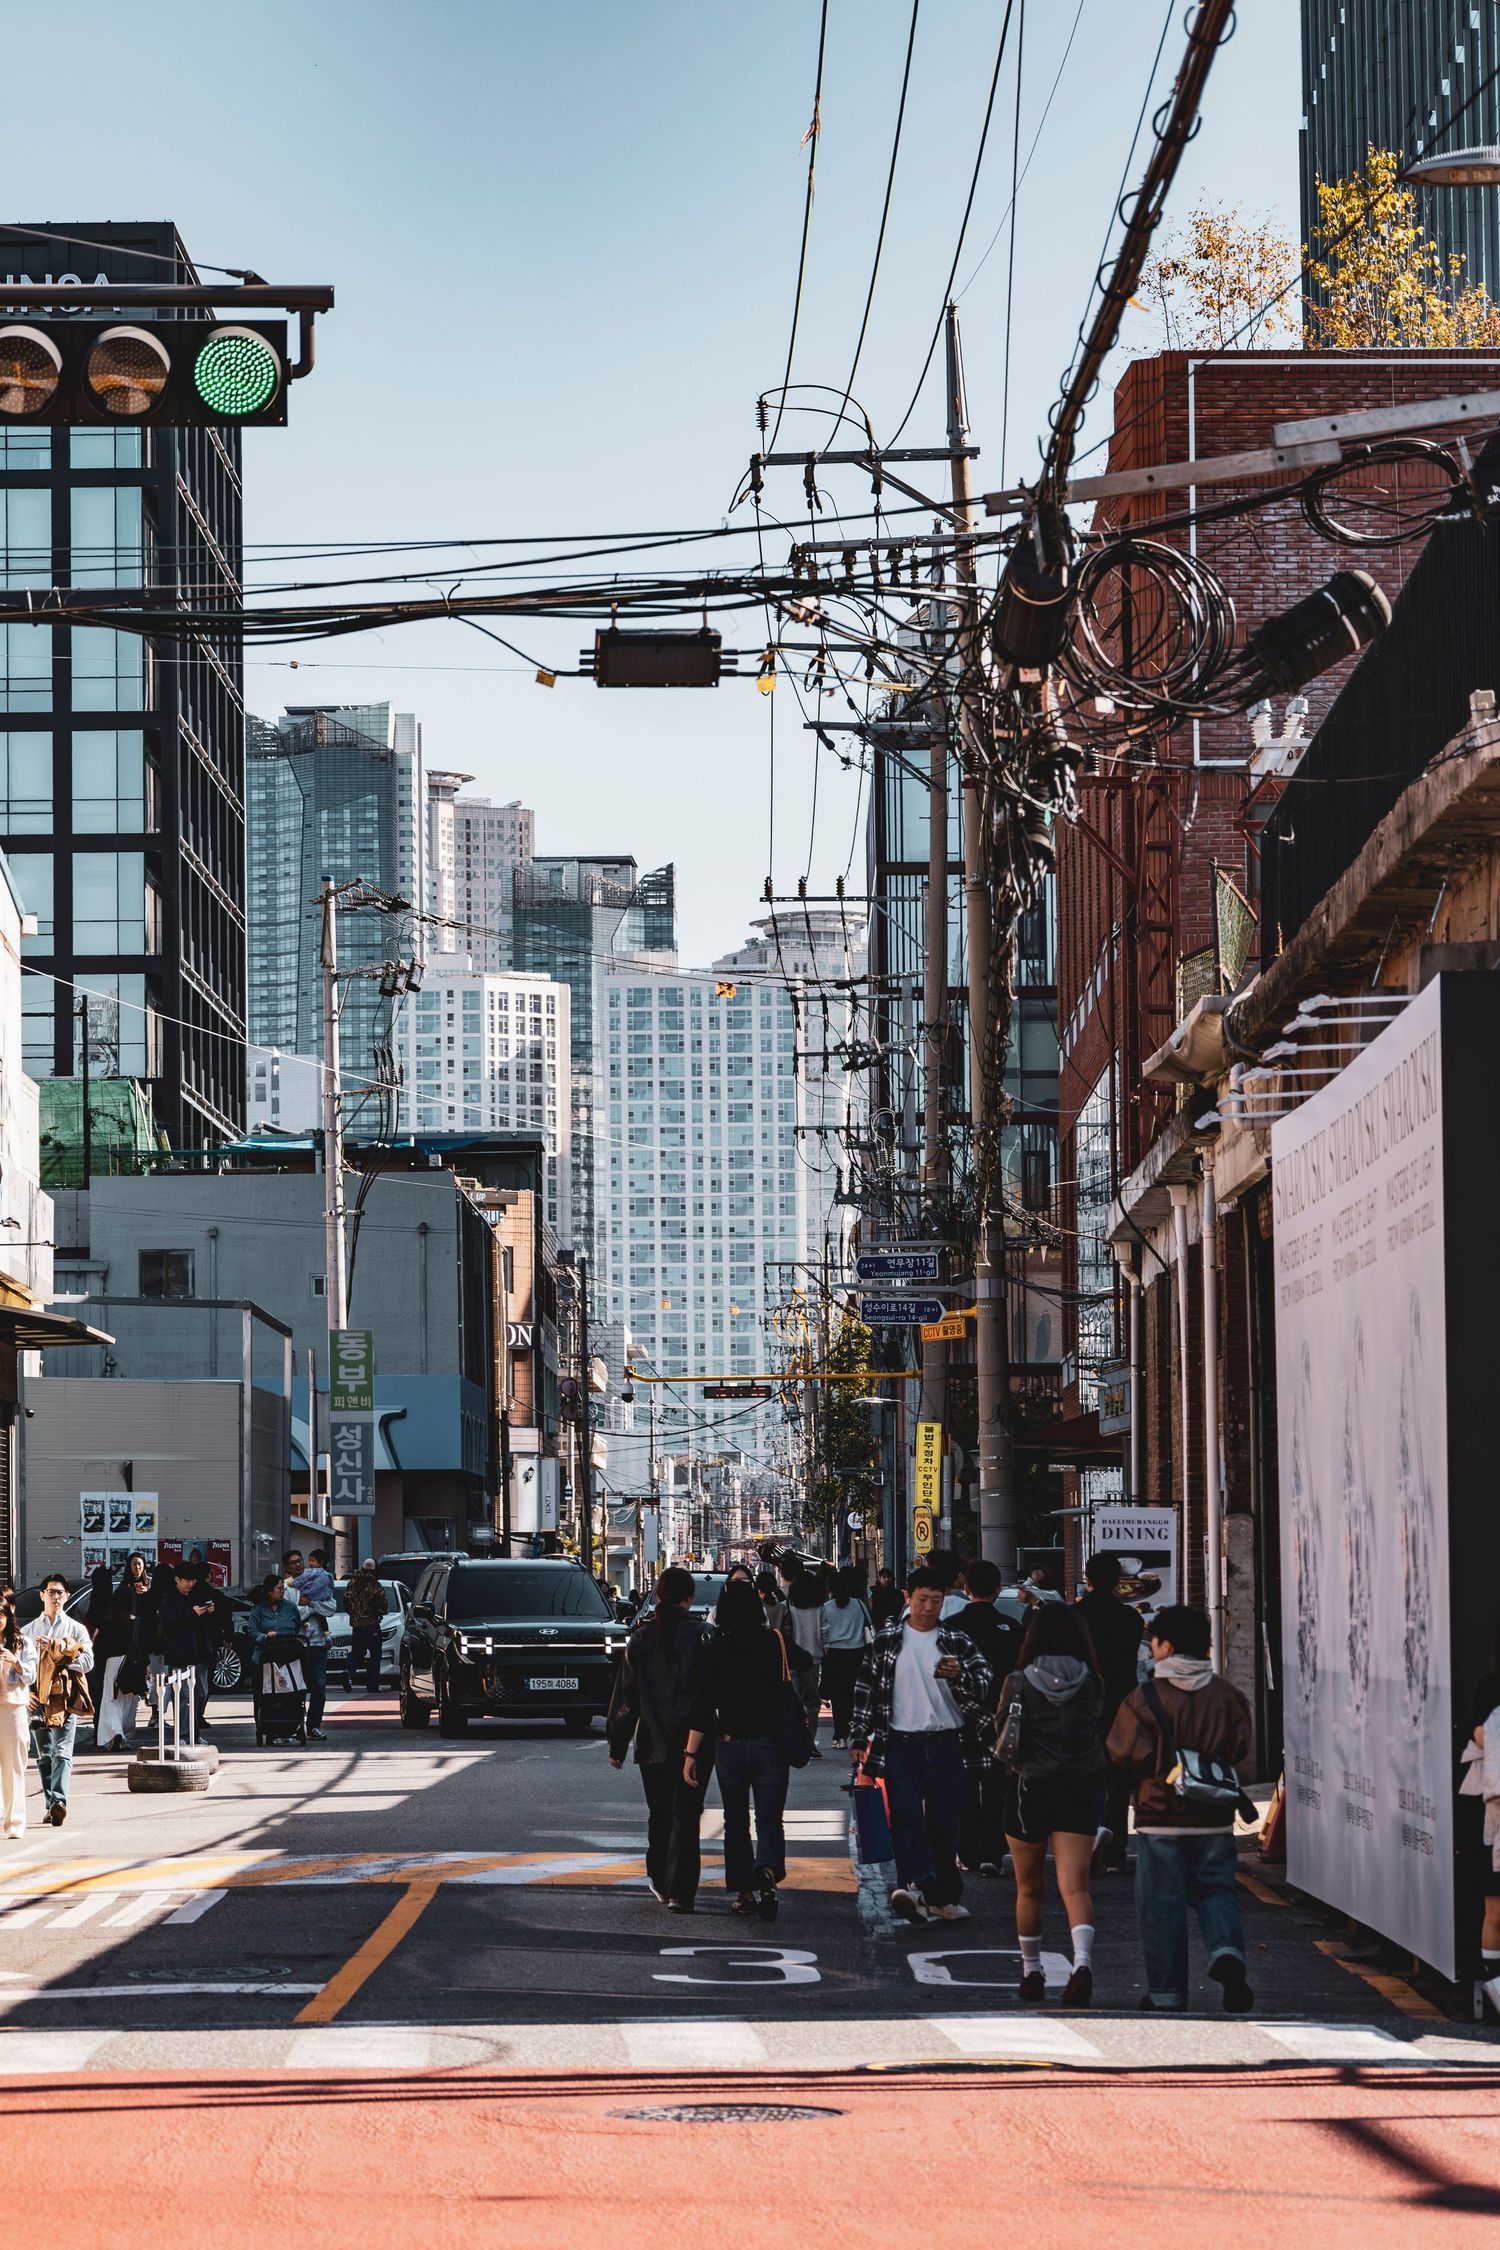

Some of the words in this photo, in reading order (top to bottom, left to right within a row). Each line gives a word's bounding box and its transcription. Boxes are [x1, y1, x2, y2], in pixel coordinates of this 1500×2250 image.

[887, 1257, 935, 1269] 연무장11길
[870, 1270, 914, 1278] Yeonmujang
[915, 1268, 935, 1276] 11-gil
[864, 1303, 916, 1314] 성수이로14길
[864, 1313, 906, 1321] Seongsui-ro
[908, 1314, 928, 1322] 14-gil
[923, 1326, 941, 1338] CCTV
[336, 1332, 368, 1393] 동부
[333, 1395, 371, 1408] 피앤비
[923, 1426, 934, 1465] 불법주정차
[334, 1425, 366, 1503] 성신사
[1102, 1527, 1168, 1540] DINING
[555, 1679, 577, 1688] 4086
